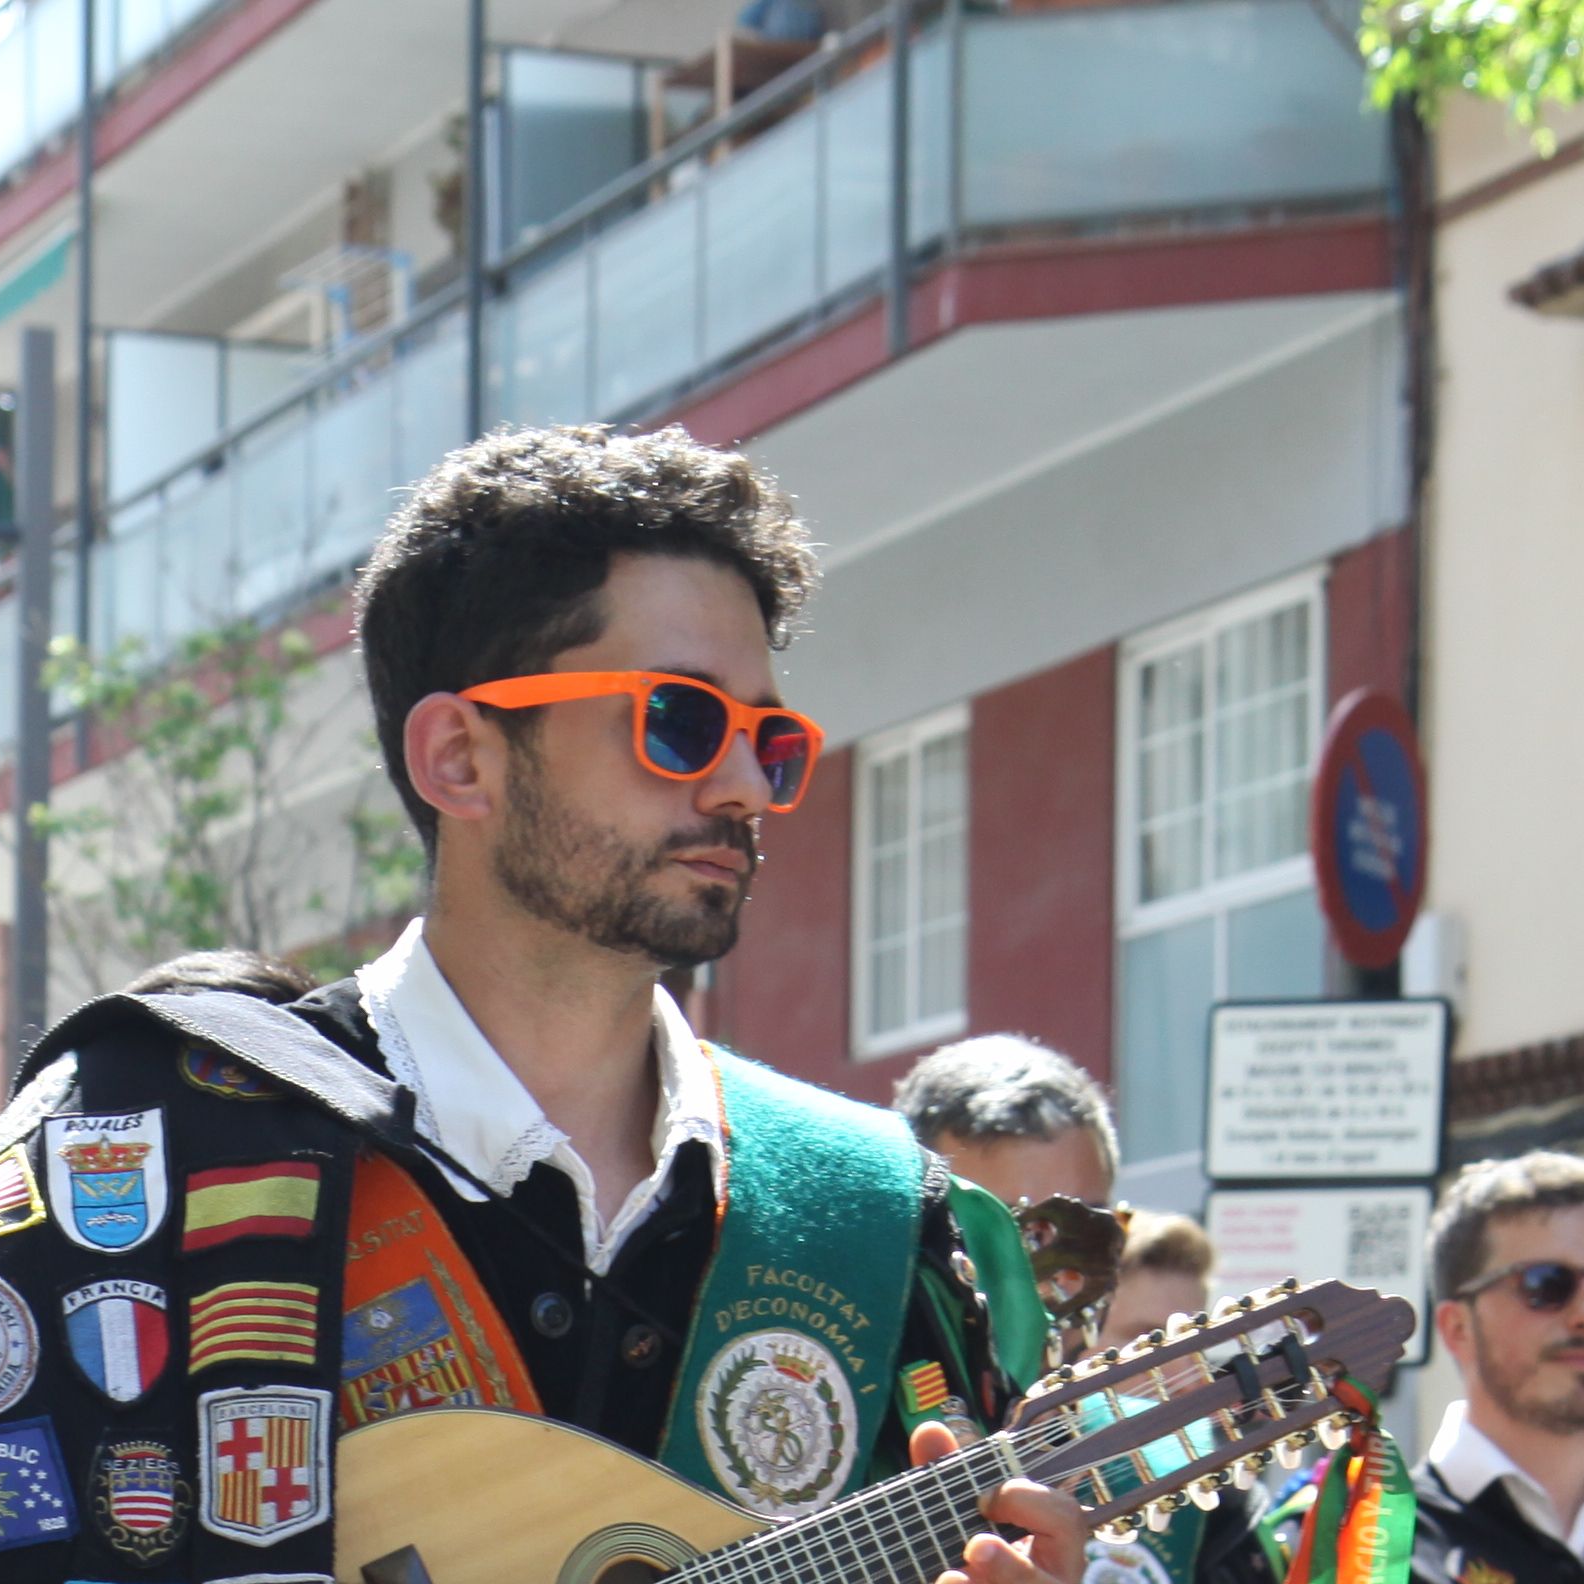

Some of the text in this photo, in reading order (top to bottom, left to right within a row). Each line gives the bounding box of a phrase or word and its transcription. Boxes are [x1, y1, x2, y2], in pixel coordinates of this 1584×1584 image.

[63, 1114, 144, 1133] ROJALES
[66, 1281, 166, 1307] FRANCIA
[218, 1403, 308, 1420] BARCELONA
[100, 1457, 181, 1475] BEZIERS
[1360, 1499, 1393, 1516] Y
